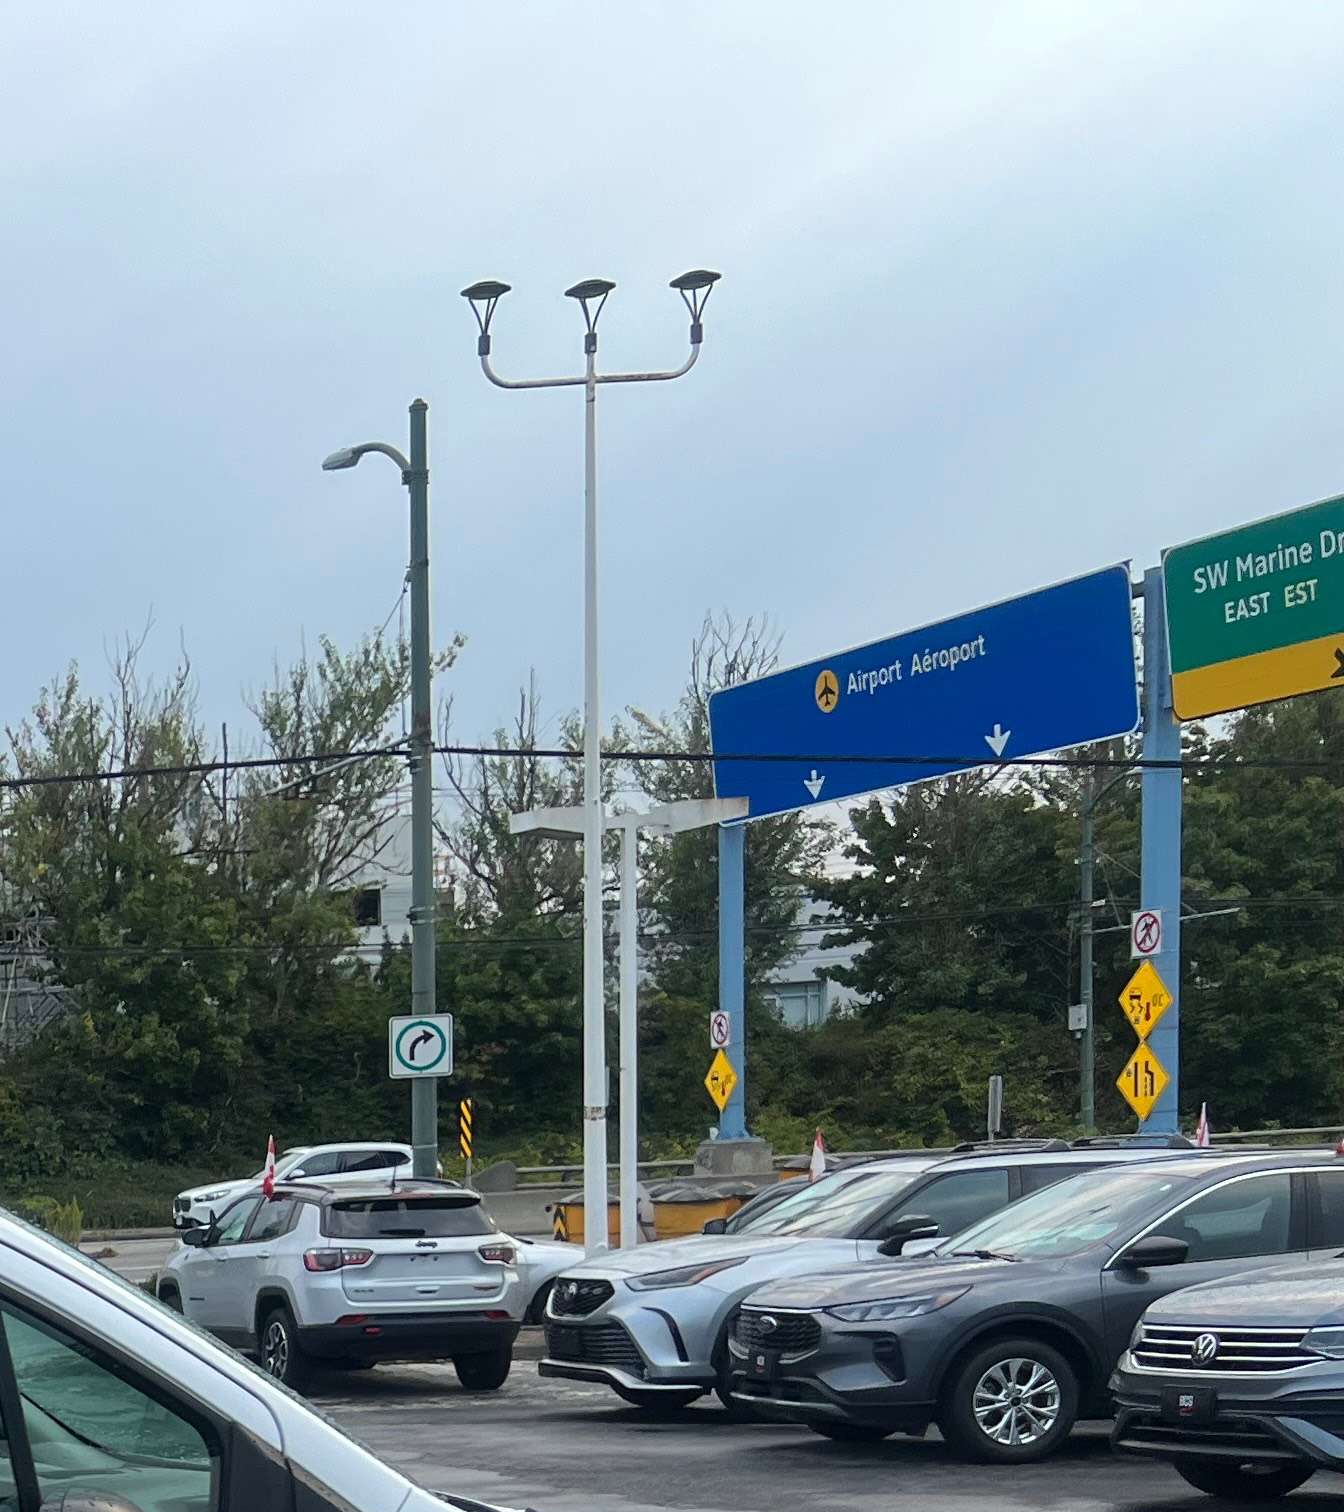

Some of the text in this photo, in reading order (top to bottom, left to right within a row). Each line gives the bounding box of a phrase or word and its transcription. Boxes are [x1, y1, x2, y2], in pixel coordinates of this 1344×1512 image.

[1193, 530, 1344, 594] SW Marine Dr
[1224, 578, 1318, 624] EAST EST
[847, 634, 986, 695] Airport Aéroport
